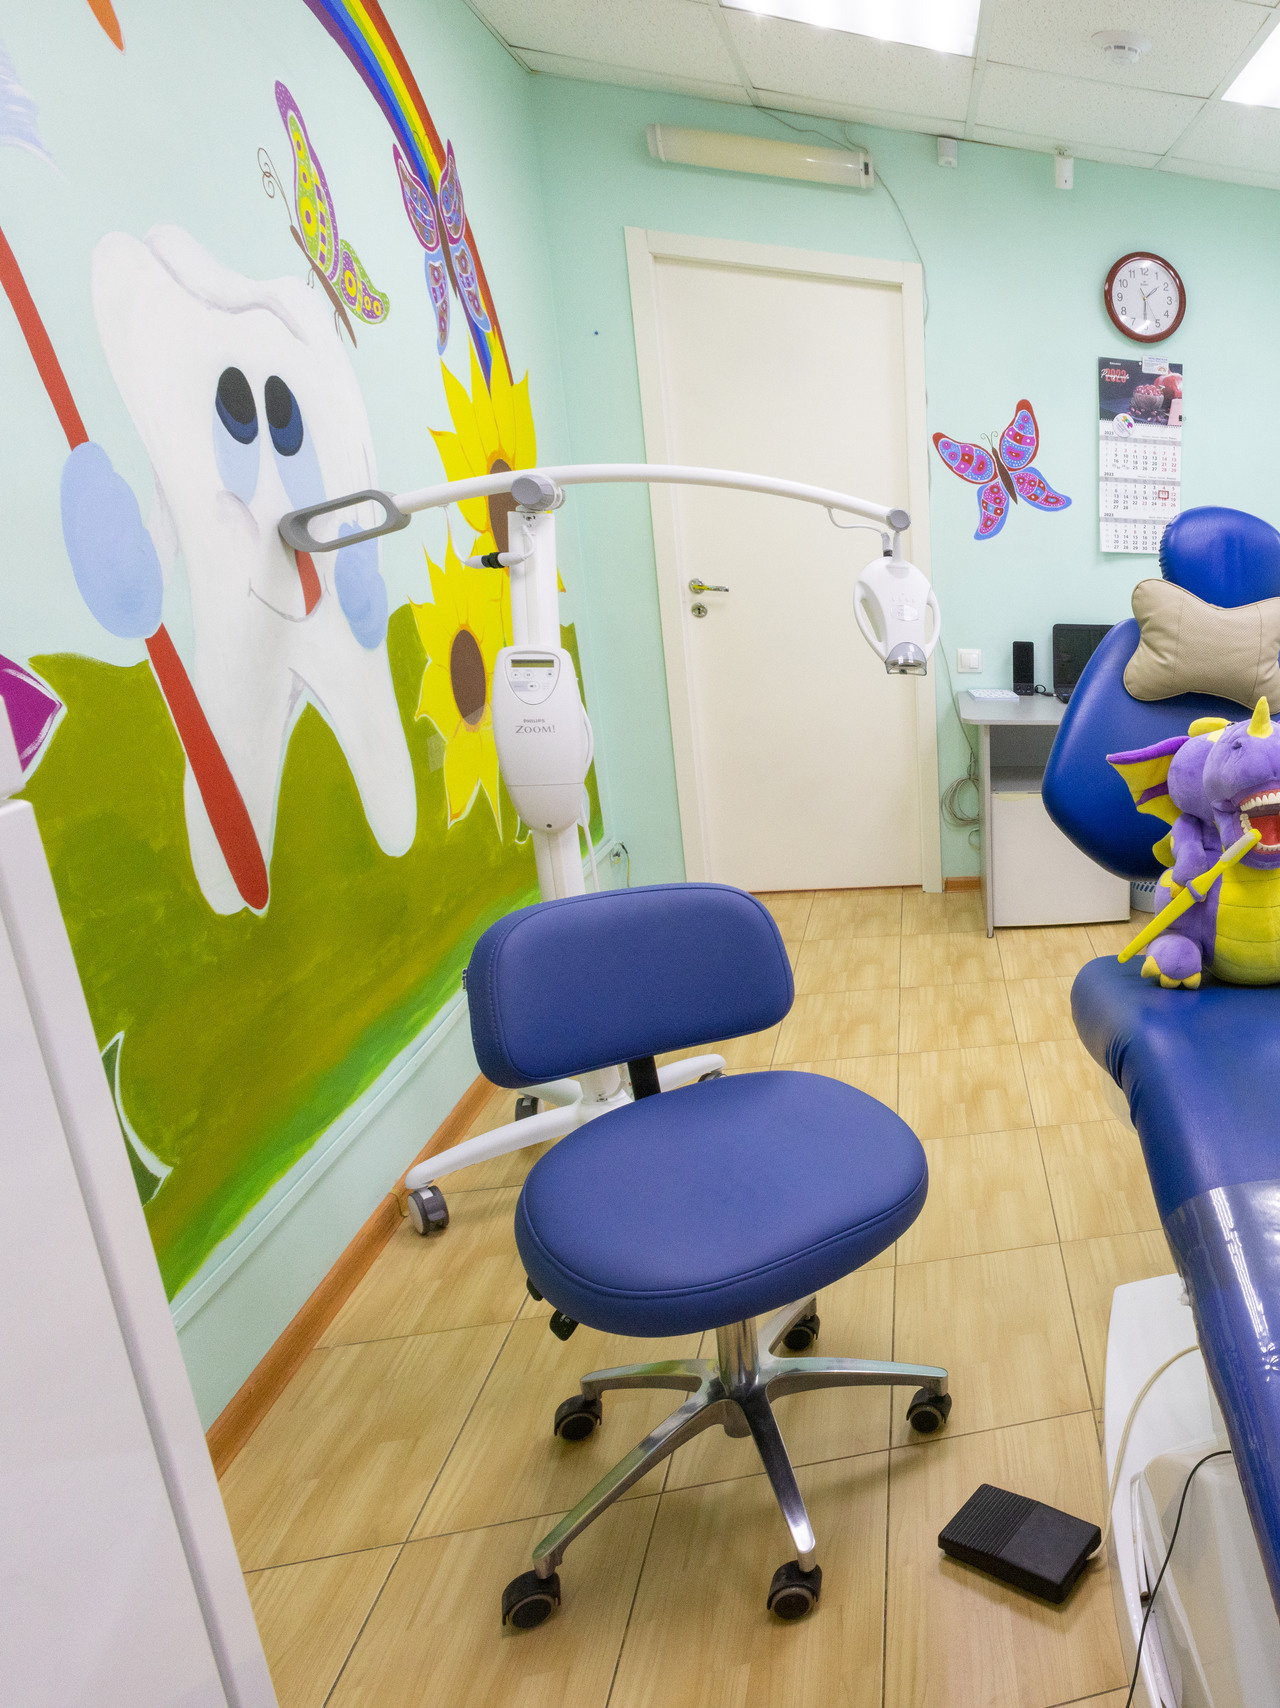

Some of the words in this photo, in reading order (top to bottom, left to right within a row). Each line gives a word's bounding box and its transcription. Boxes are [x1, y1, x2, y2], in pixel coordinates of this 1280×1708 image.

[1128, 270, 1136, 278] 11
[1140, 268, 1149, 276] 12
[1155, 272, 1158, 280] 1
[1119, 279, 1128, 288] 10
[1163, 282, 1168, 291] 2
[1117, 292, 1123, 302] 9
[1166, 296, 1172, 306] 3
[1121, 306, 1127, 316] 8
[1164, 310, 1169, 318] 4
[1131, 318, 1136, 326] 7
[1155, 319, 1160, 328] 5
[515, 725, 556, 734] ZOOM!
